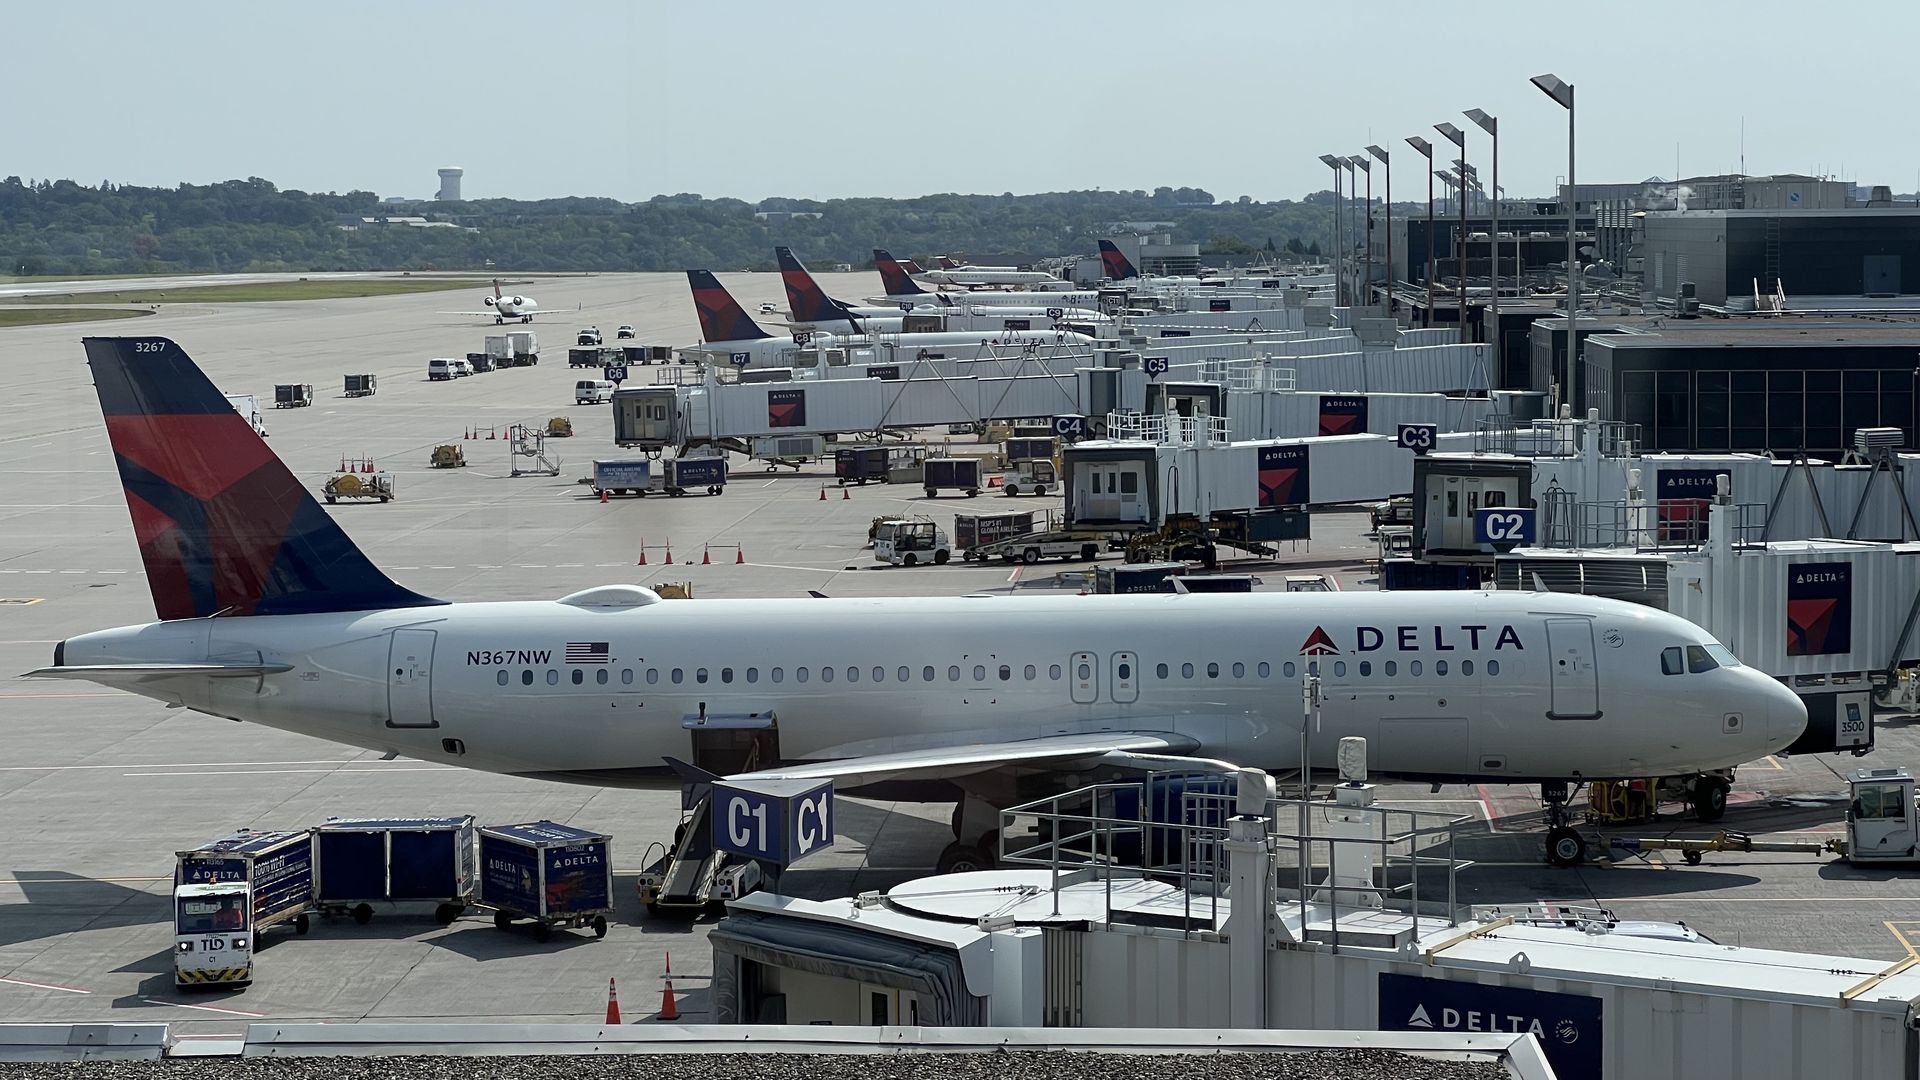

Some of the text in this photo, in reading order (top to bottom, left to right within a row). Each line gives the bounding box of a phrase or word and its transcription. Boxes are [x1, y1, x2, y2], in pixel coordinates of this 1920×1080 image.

[796, 334, 808, 342] C8
[136, 342, 165, 352] 3267
[733, 354, 746, 363] C7
[1148, 359, 1166, 371] C5
[608, 368, 622, 379] C6
[1056, 418, 1081, 434] C4
[1402, 427, 1430, 447] C3
[1678, 478, 1713, 486] DELTA
[1486, 513, 1524, 539] C2
[1806, 573, 1836, 582] DELTA
[1356, 625, 1524, 651] DELTA
[467, 650, 552, 666] N367NW
[1842, 721, 1864, 732] 3500
[728, 796, 766, 851] C1
[798, 792, 827, 854] C1
[564, 856, 598, 866] DELTA
[495, 860, 516, 874] DELTA
[204, 871, 240, 879] DELTA
[201, 939, 224, 950] TLD
[1443, 1008, 1545, 1039] DELTA
